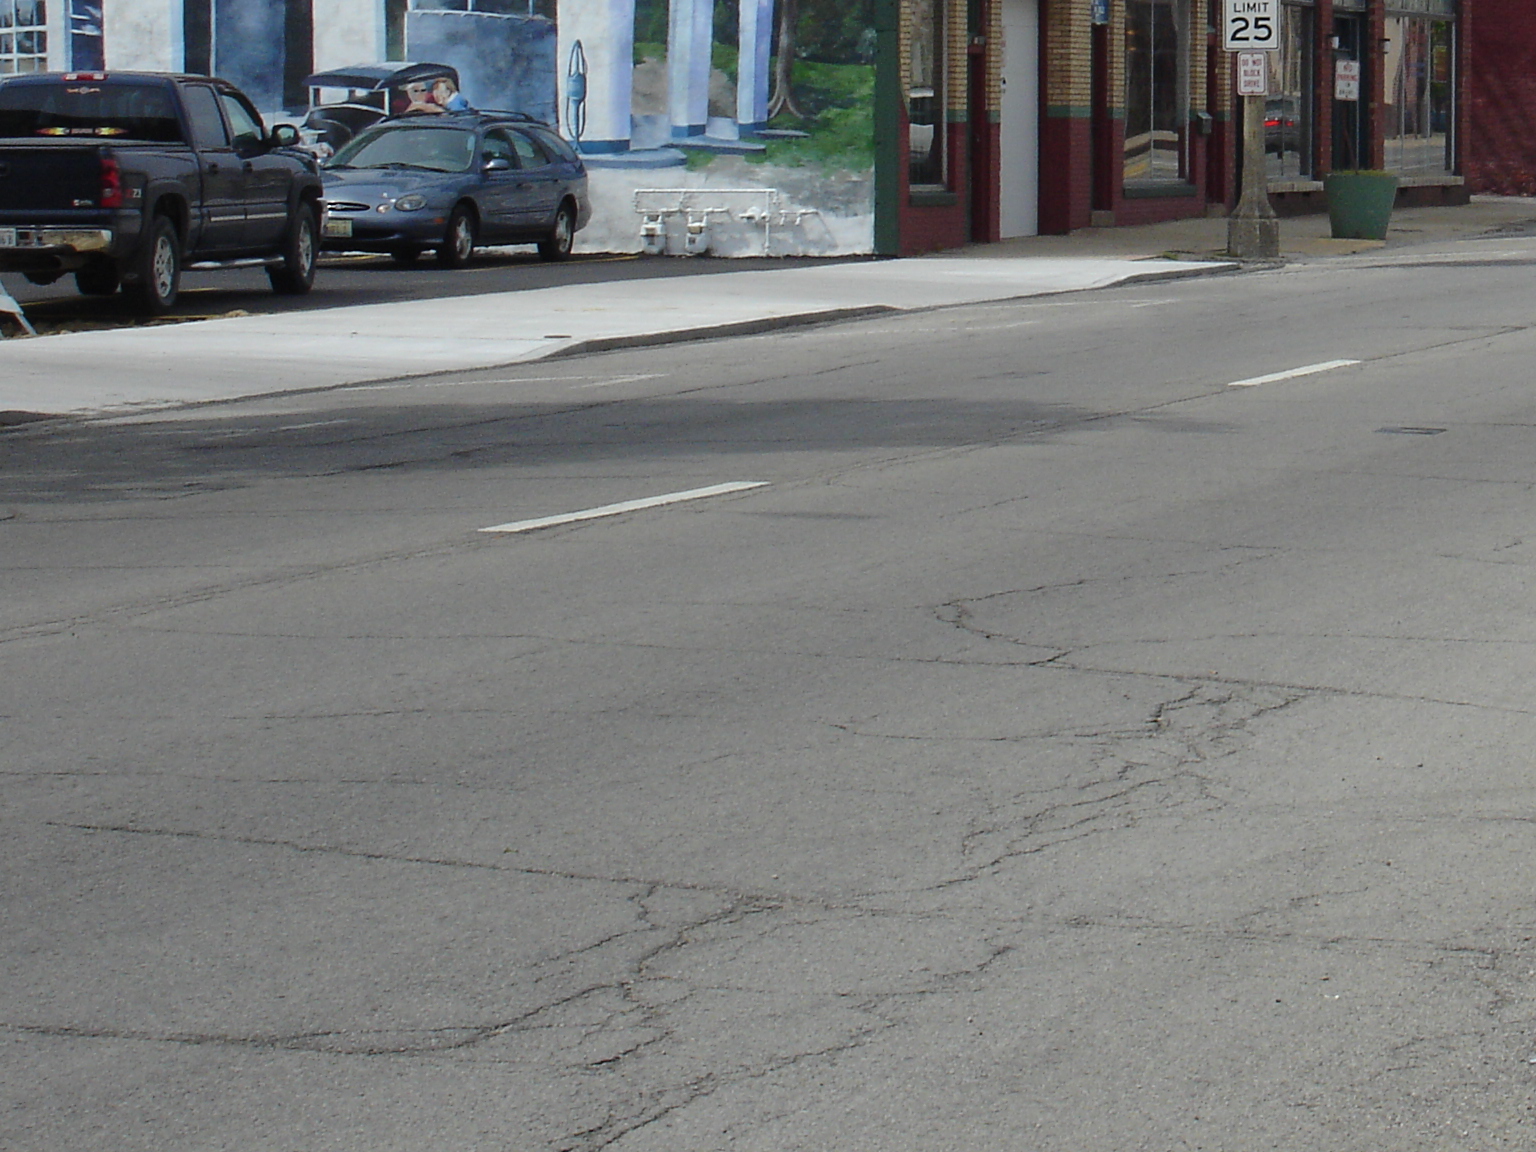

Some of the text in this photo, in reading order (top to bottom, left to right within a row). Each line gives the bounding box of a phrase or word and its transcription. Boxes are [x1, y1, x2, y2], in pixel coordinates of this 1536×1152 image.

[1233, 2, 1269, 13] LIMIT
[1230, 16, 1273, 42] 25
[1243, 69, 1260, 77] BLOCK
